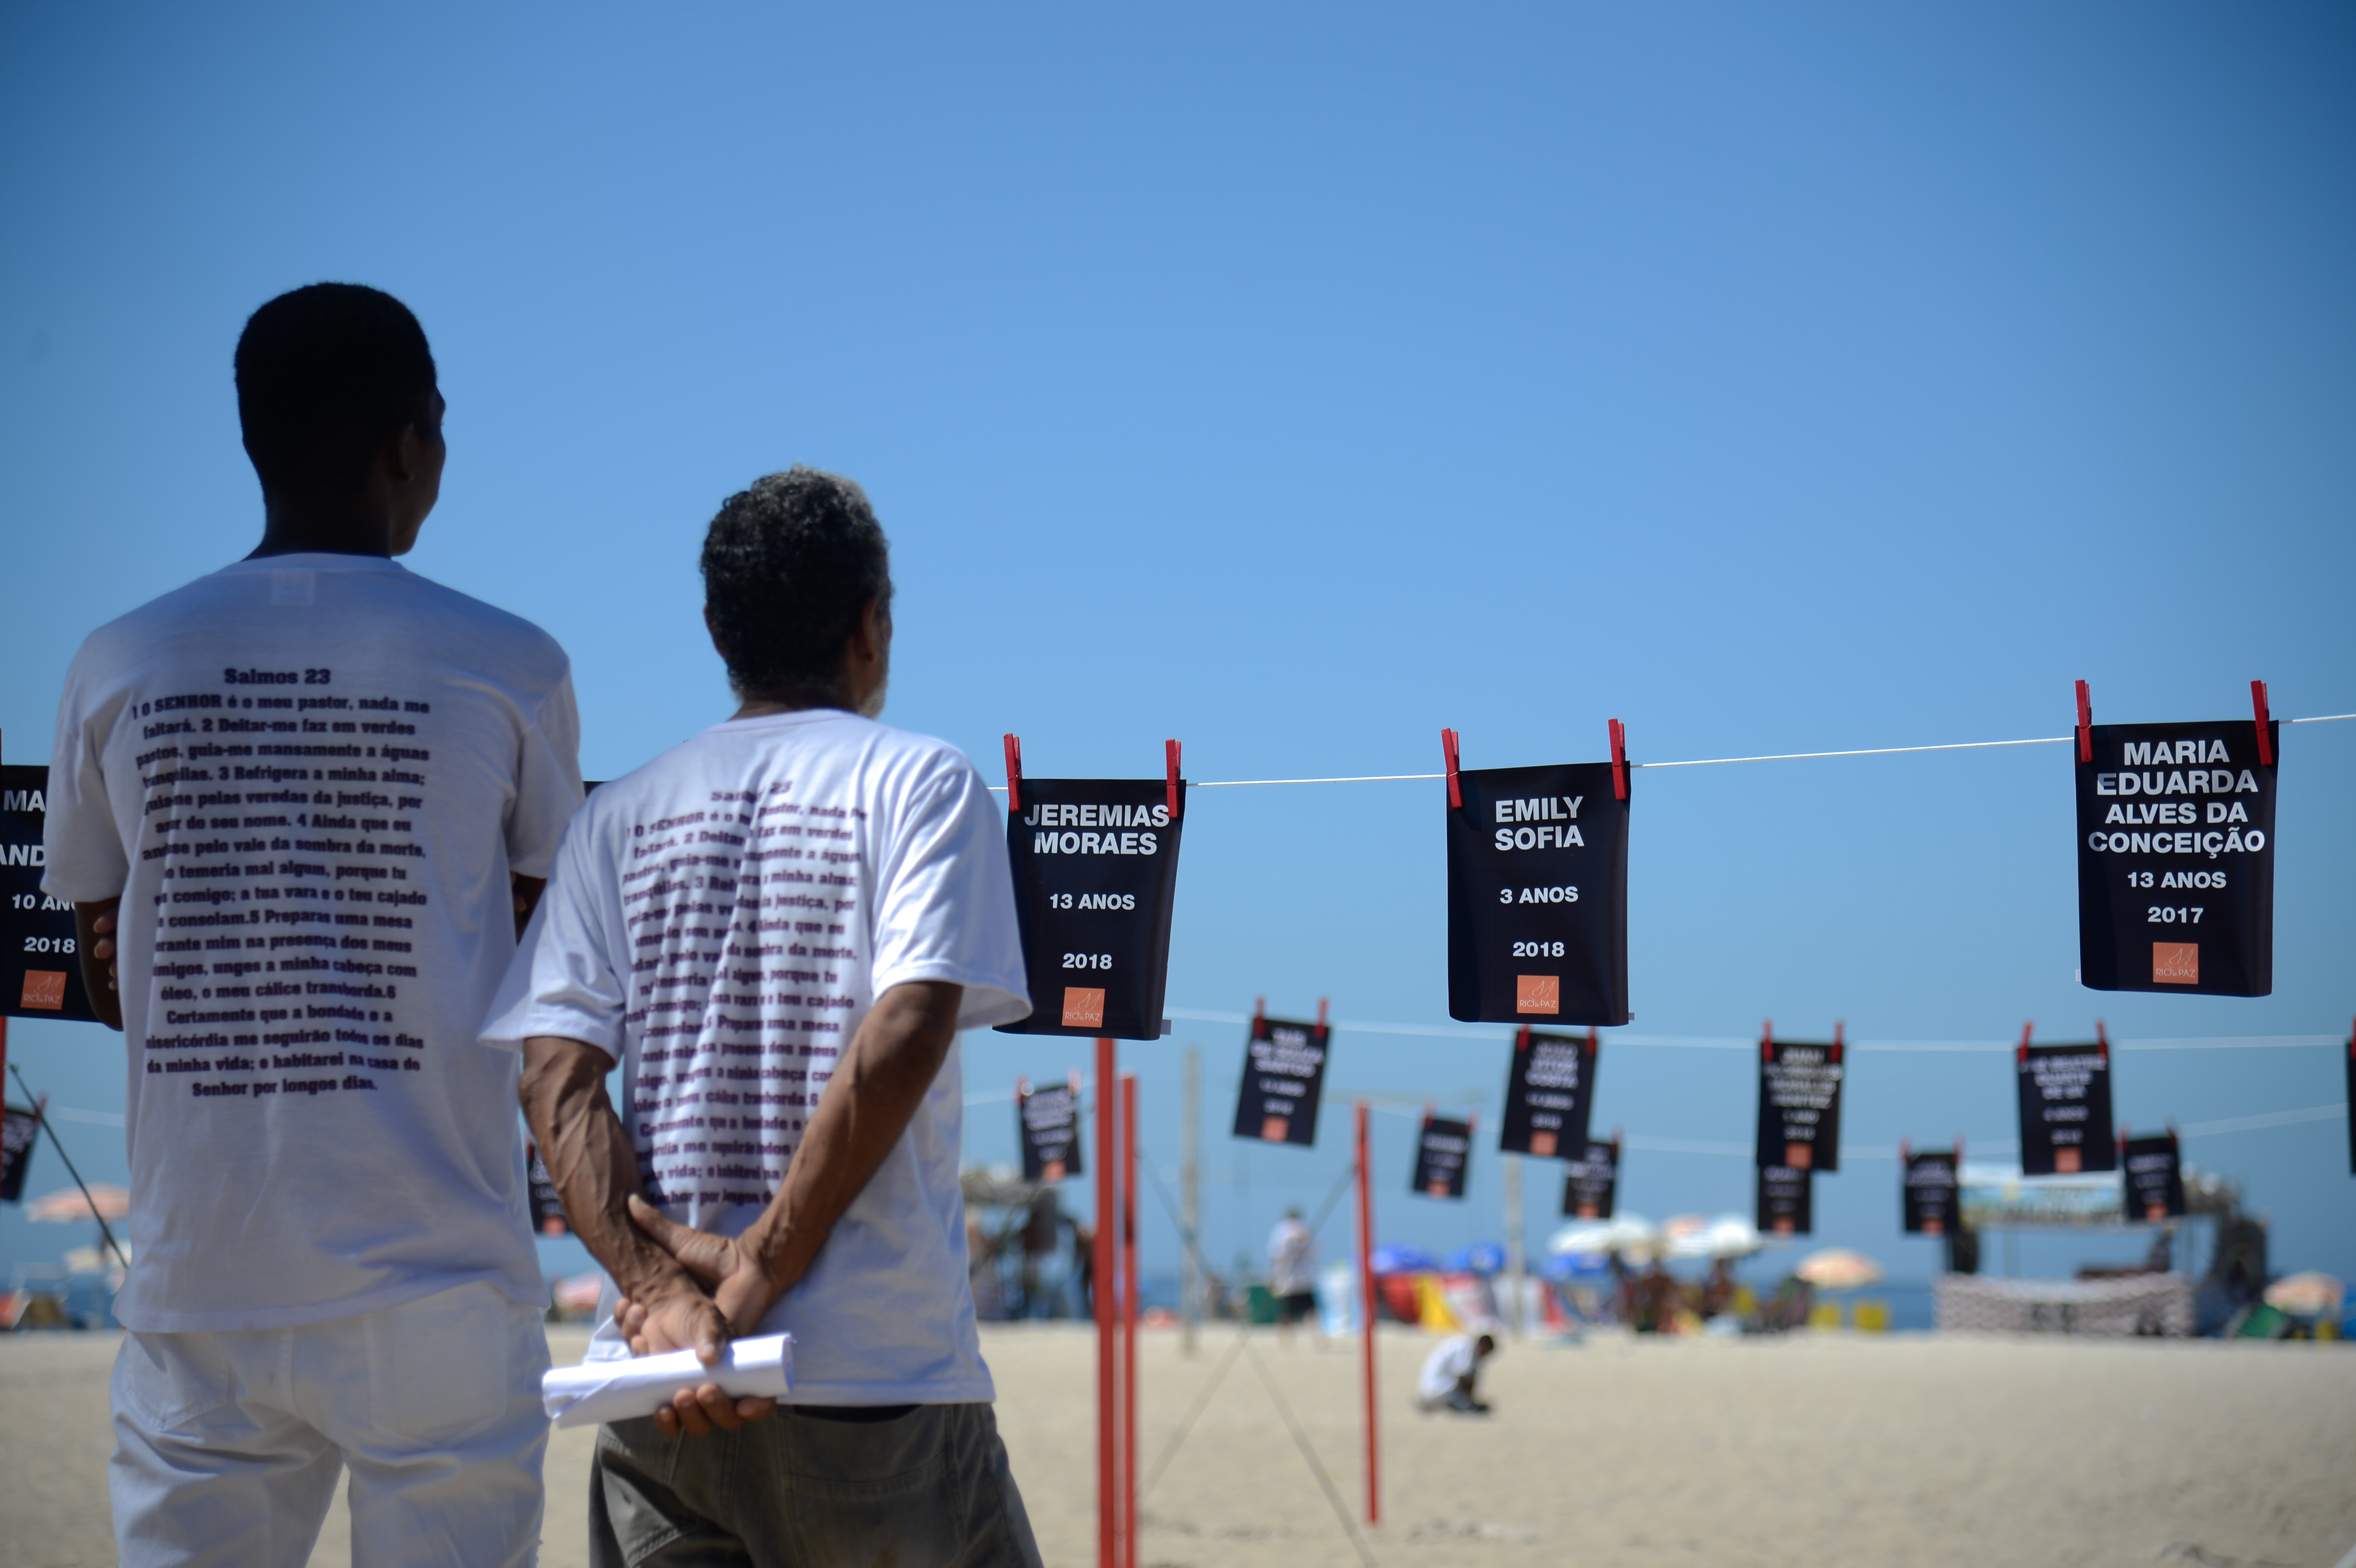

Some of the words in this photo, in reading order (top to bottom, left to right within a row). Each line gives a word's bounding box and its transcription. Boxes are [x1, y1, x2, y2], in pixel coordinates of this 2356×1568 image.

[224, 668, 298, 685] Salmos
[304, 669, 331, 685] 23
[154, 694, 222, 712] SENHOR
[227, 695, 236, 708] é
[242, 697, 252, 708] o
[257, 697, 293, 708] meu
[298, 696, 353, 712] pastor,
[359, 697, 399, 711] nada
[404, 701, 430, 714] me
[202, 718, 213, 732] 2
[218, 718, 297, 732] Deitar-me
[302, 718, 327, 732] faz
[332, 722, 356, 733] em
[361, 720, 415, 735] verdes
[187, 742, 253, 761] guia-me
[258, 744, 362, 757] mansamente
[366, 747, 376, 757] a
[381, 744, 429, 762] águas
[2124, 740, 2230, 766] MARIA
[218, 766, 229, 781] 3
[234, 765, 308, 783] Refrigera
[313, 769, 323, 780] a
[327, 767, 377, 782] minha
[382, 768, 425, 786] alma;
[2097, 770, 2258, 795] EDUARDA
[197, 791, 241, 809] pelas
[246, 789, 308, 804] veredas
[313, 790, 333, 804] da
[337, 791, 393, 808] justiça,
[398, 796, 423, 810] por
[1025, 804, 1170, 827] JEREMIAS
[1495, 795, 1583, 823] EMILY
[2105, 802, 2197, 824] ALVES
[2207, 802, 2248, 823] DA
[186, 816, 206, 829] do
[210, 817, 239, 829] seu
[243, 816, 292, 828] nome.
[297, 813, 307, 827] 4
[311, 814, 356, 829] Ainda
[361, 819, 388, 833] que
[393, 820, 411, 832] eu
[1034, 832, 1157, 855] MORAES
[1494, 825, 1585, 851] SOFIA
[2088, 827, 2266, 859] CONCEIÇÃO
[195, 839, 229, 857] pelo
[233, 838, 266, 852] vale
[271, 837, 291, 850] da
[295, 838, 352, 853] sombra
[356, 839, 375, 854] da
[380, 843, 425, 858] morte,
[179, 862, 240, 878] temeria
[245, 861, 274, 876] mal
[279, 860, 330, 878] algum,
[336, 866, 388, 881] porque
[772, 870, 813, 883] minha
[2127, 871, 2154, 888] 13
[2160, 871, 2226, 889] ANOS
[12, 894, 35, 909] 10
[172, 888, 235, 905] comigo;
[240, 889, 250, 900] a
[254, 887, 280, 900] tua
[284, 887, 318, 900] vara
[321, 888, 330, 900] e
[334, 890, 344, 901] o
[349, 888, 372, 902] teu
[377, 890, 427, 907] cajado
[1050, 893, 1072, 909] 13
[1078, 893, 1135, 910] ANOS
[1500, 888, 1512, 904] 3
[1519, 886, 1579, 904] ANOS
[264, 909, 331, 926] Preparas
[334, 913, 369, 926] uma
[373, 915, 413, 928] mesa
[2148, 906, 2203, 924] 2017
[795, 922, 823, 935] que
[24, 936, 75, 954] 2018
[205, 936, 241, 950] mim
[246, 937, 265, 948] na
[270, 935, 337, 951] presença
[340, 936, 368, 949] dos
[372, 940, 412, 953] meus
[789, 943, 807, 957] da
[1513, 941, 1565, 957] 2018
[213, 961, 261, 977] unges
[266, 961, 275, 972] a
[280, 956, 330, 972] minha
[333, 957, 382, 976] cabeça
[387, 965, 417, 977] com
[1062, 953, 1112, 969] 2018
[2156, 968, 2172, 976] RIO
[2179, 969, 2195, 977] PAZ
[24, 993, 39, 1002] RIO
[44, 994, 60, 1004] PAZ
[161, 986, 197, 1001] óleo,
[202, 988, 211, 999] o
[216, 986, 251, 998] meu
[255, 981, 302, 997] cálice
[807, 995, 854, 1010] cajado
[1540, 1000, 1556, 1008] PAZ
[166, 1009, 255, 1024] Certamente
[260, 1009, 288, 1024] que
[293, 1008, 303, 1019] a
[369, 1010, 379, 1022] e
[383, 1012, 393, 1022] a
[1085, 1013, 1100, 1021] PAZ
[801, 1020, 839, 1032] mesa
[233, 1034, 258, 1045] me
[263, 1029, 331, 1048] seguirão
[372, 1034, 391, 1046] os
[395, 1033, 424, 1049] dias
[798, 1045, 837, 1057] meus
[165, 1058, 211, 1072] minha
[215, 1056, 254, 1071] vida;
[259, 1058, 268, 1069] e
[273, 1052, 344, 1068] habitarei
[404, 1057, 420, 1071] do
[192, 1081, 248, 1097] Senhor
[253, 1083, 277, 1098] por
[283, 1078, 338, 1095] longos
